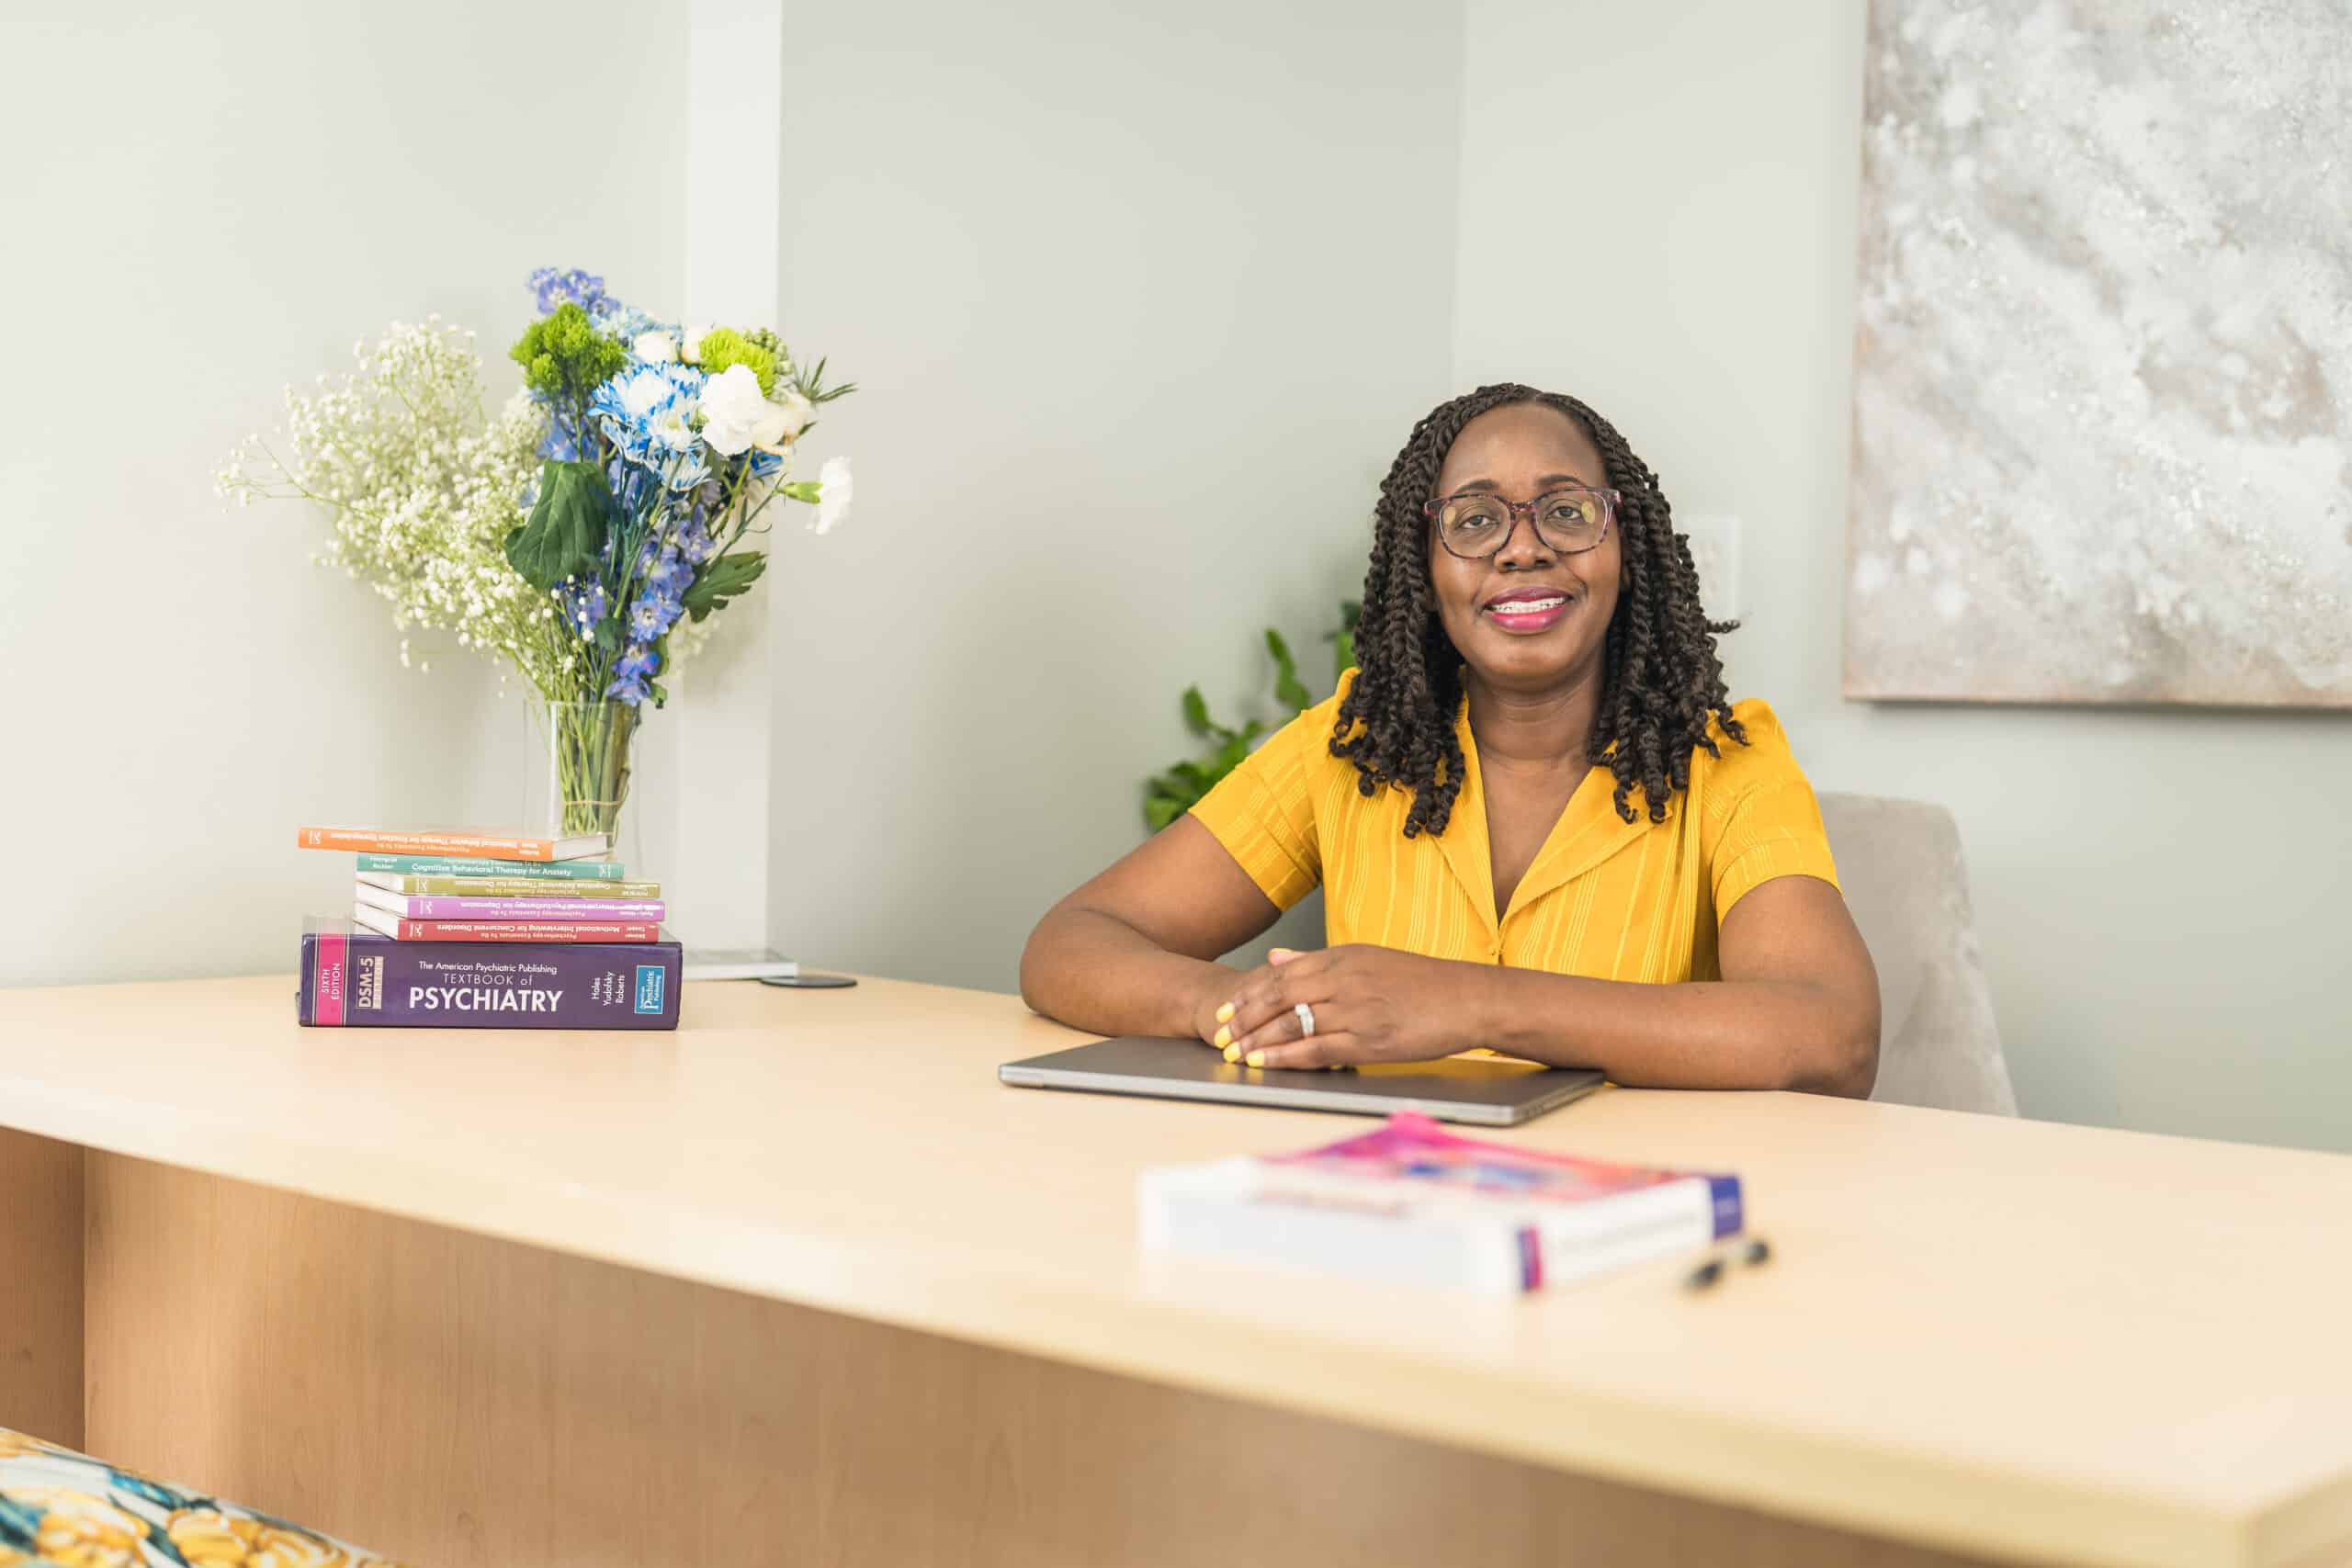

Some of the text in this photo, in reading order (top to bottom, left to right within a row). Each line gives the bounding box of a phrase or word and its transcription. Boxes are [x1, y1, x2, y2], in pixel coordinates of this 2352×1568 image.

[411, 863, 450, 873] Cognitive
[451, 864, 493, 873] Behavioral
[494, 866, 526, 875] Therapy
[542, 868, 572, 876] Anxiety
[437, 924, 472, 932] Disorders
[528, 924, 574, 933] Interviewing
[576, 925, 620, 933] Motivational
[419, 961, 558, 976] The American Psychiatric Publishing
[443, 973, 533, 986] TEXTBOOK of
[322, 969, 330, 993] SIXTH
[331, 963, 340, 1000] EDITION
[358, 957, 374, 1008] DSM-5
[591, 977, 601, 1000] Hales
[603, 971, 616, 1007] Yudofsky
[615, 975, 625, 1004] Roberts
[409, 987, 564, 1012] PSYCHIATRY
